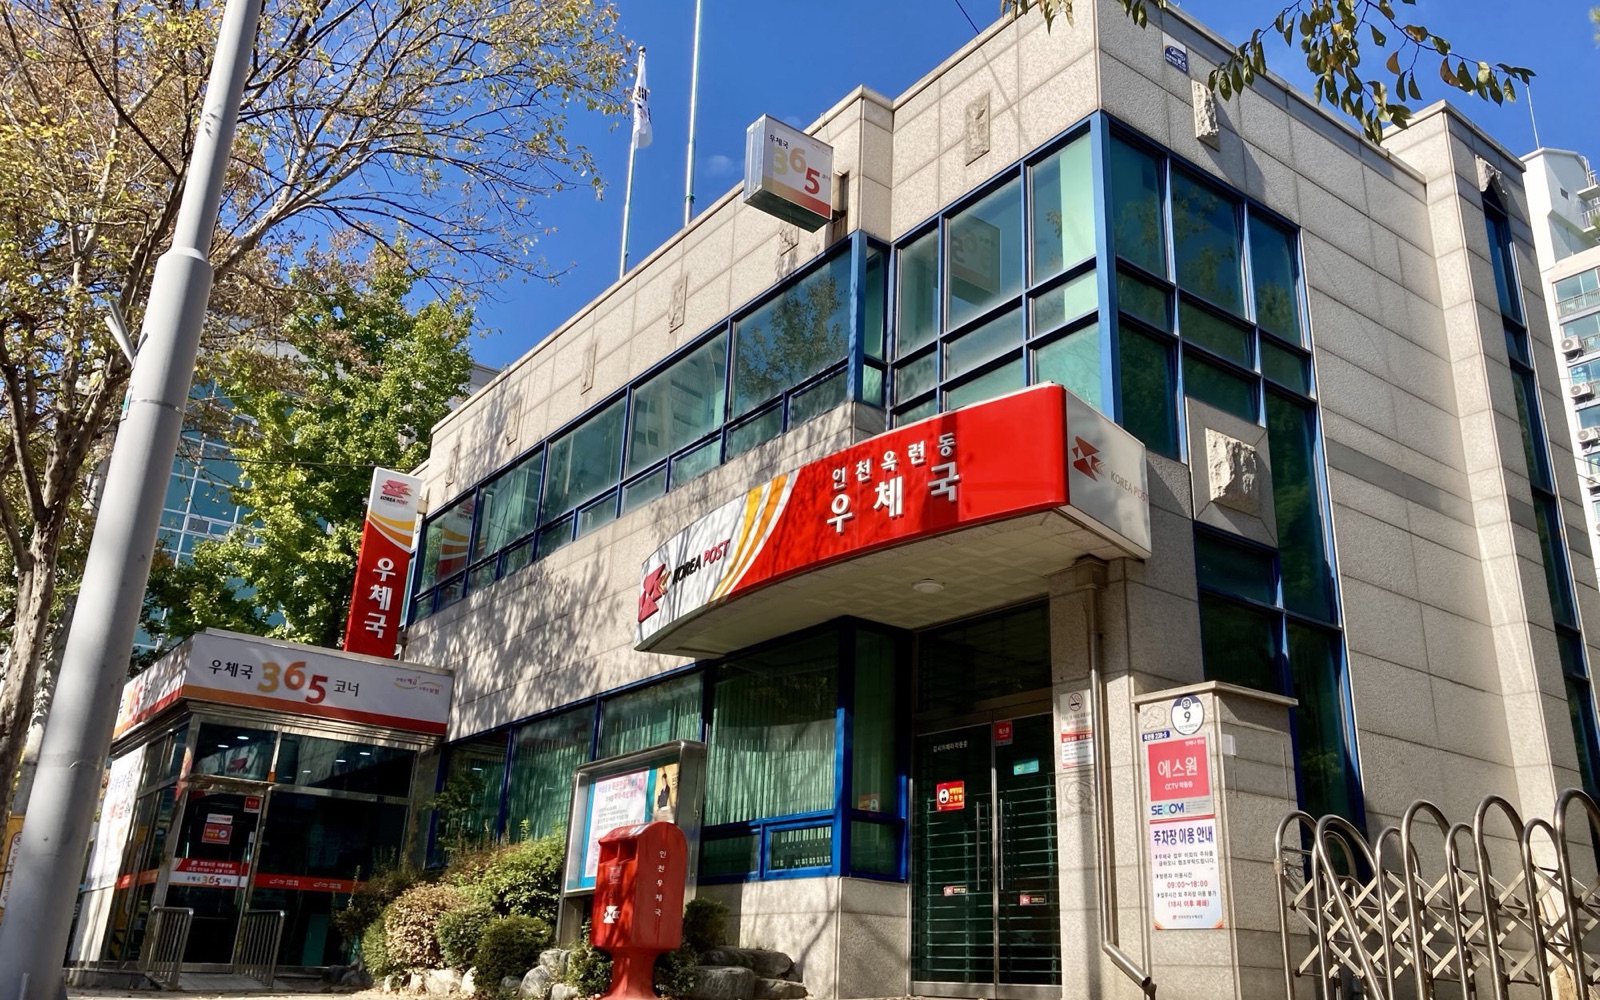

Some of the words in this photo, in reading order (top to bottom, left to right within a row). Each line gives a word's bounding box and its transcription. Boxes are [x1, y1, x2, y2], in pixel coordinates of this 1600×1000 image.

[769, 134, 789, 149] 우체국
[771, 147, 820, 194] 365
[832, 433, 956, 490] 인천옥련동
[827, 462, 960, 533] 우체국
[1110, 470, 1133, 495] KOREA
[1133, 487, 1150, 504] POST
[672, 554, 702, 585] KOREA
[703, 539, 731, 567] POST
[364, 557, 396, 639] 우체국
[208, 659, 254, 680] 우체국
[256, 661, 328, 704] 365
[333, 680, 360, 697] 코너
[1184, 711, 1191, 723] 9
[1157, 756, 1198, 779] 에스원
[1164, 783, 1179, 791] CCTV
[1151, 802, 1185, 816] SECOM
[1154, 829, 1177, 846] 주차장
[1179, 827, 1195, 844] 이용
[1196, 826, 1213, 843] 안내
[202, 875, 221, 886] 365
[1167, 880, 1208, 889] 09:00~18:00
